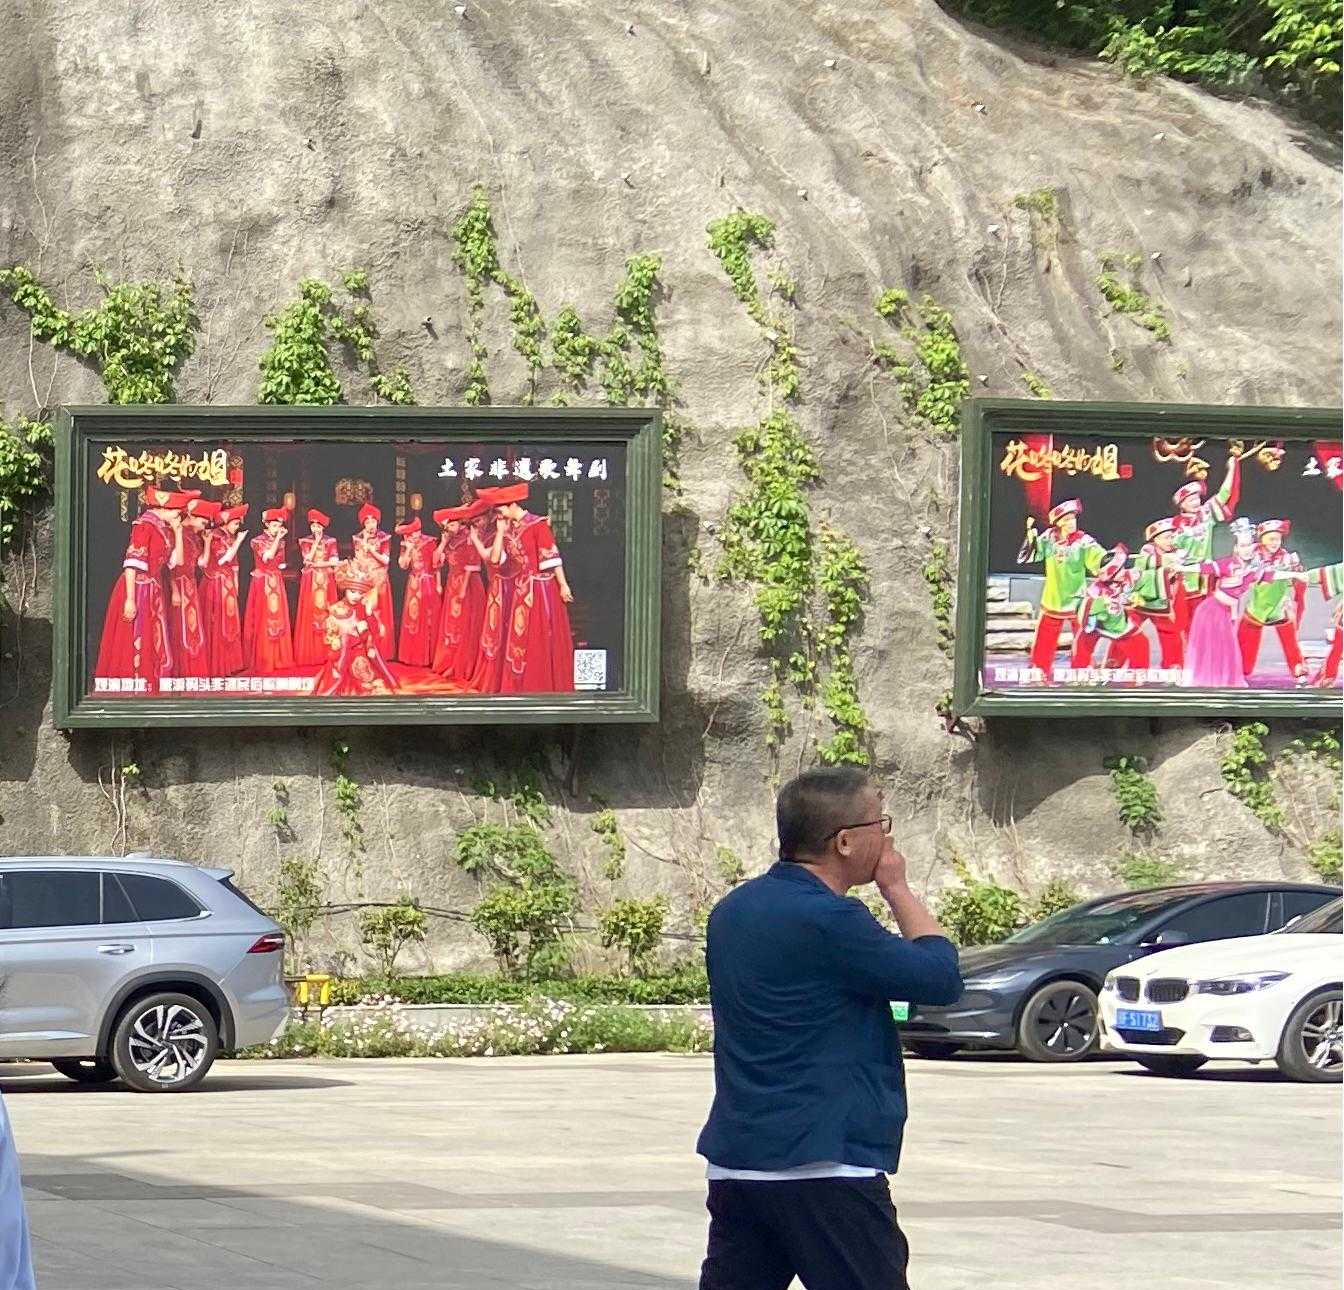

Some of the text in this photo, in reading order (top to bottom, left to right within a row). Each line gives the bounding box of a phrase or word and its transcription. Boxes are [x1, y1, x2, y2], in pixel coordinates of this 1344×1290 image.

[97, 445, 229, 488] 花咚咚的姐
